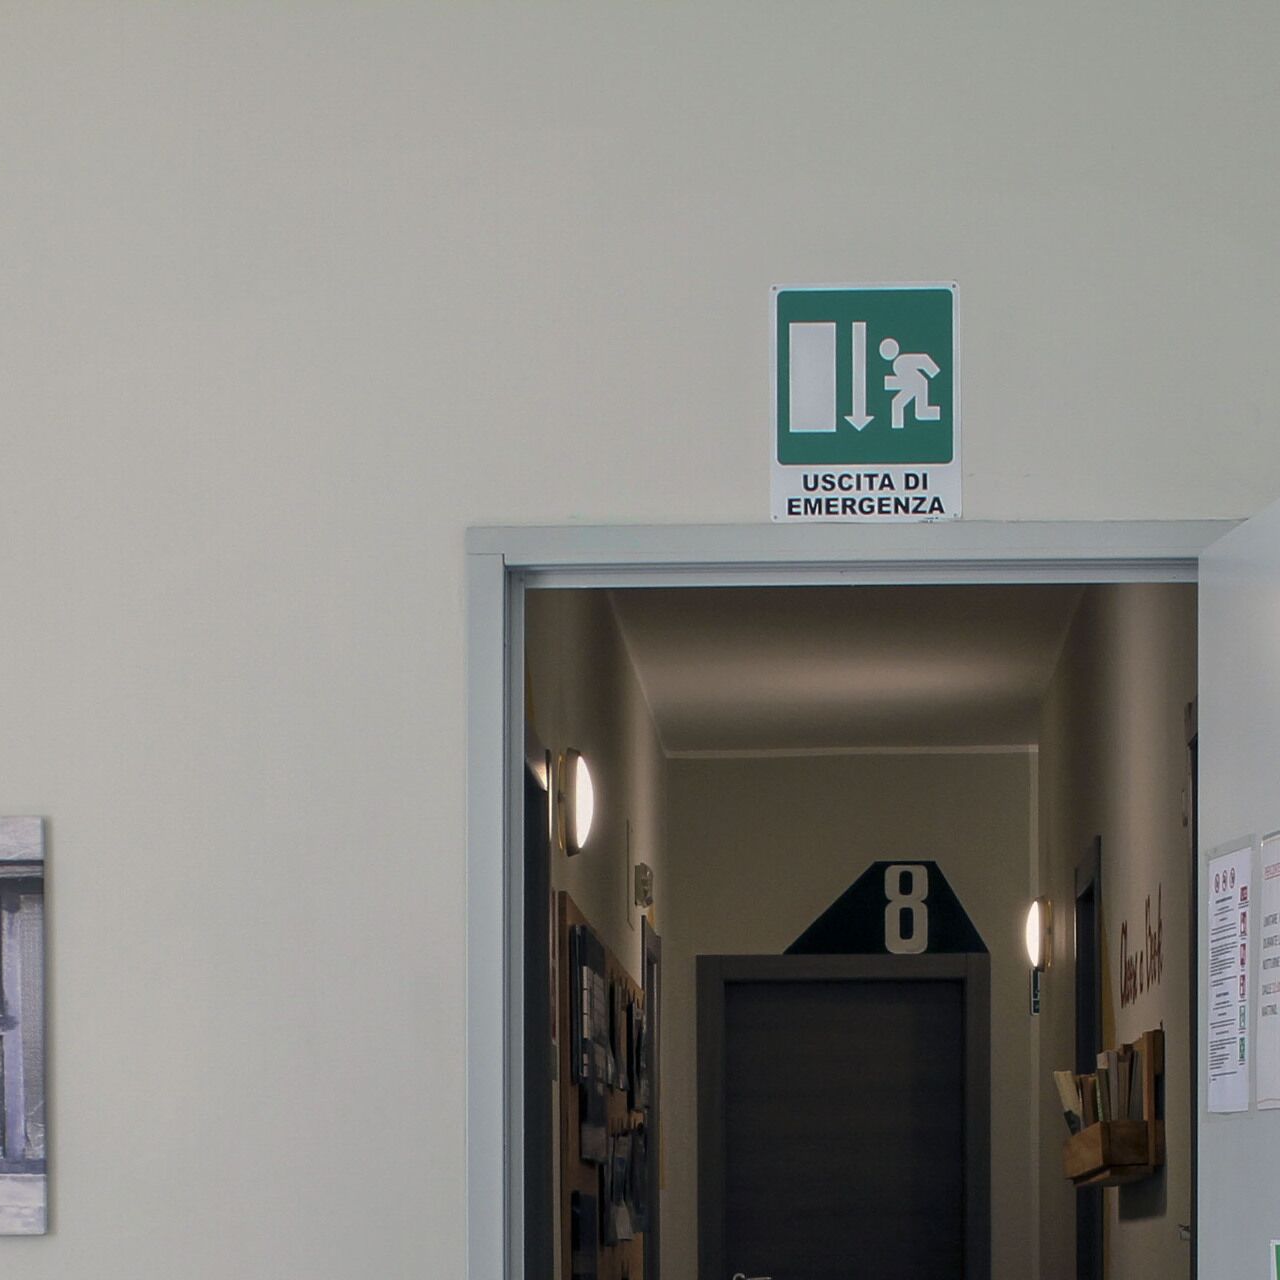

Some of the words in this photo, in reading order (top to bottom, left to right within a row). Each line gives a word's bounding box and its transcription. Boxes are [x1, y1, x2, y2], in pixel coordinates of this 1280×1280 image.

[802, 473, 895, 492] USCITA
[904, 472, 928, 491] DI
[786, 496, 945, 516] EMERGENZA
[884, 864, 928, 954] 8
